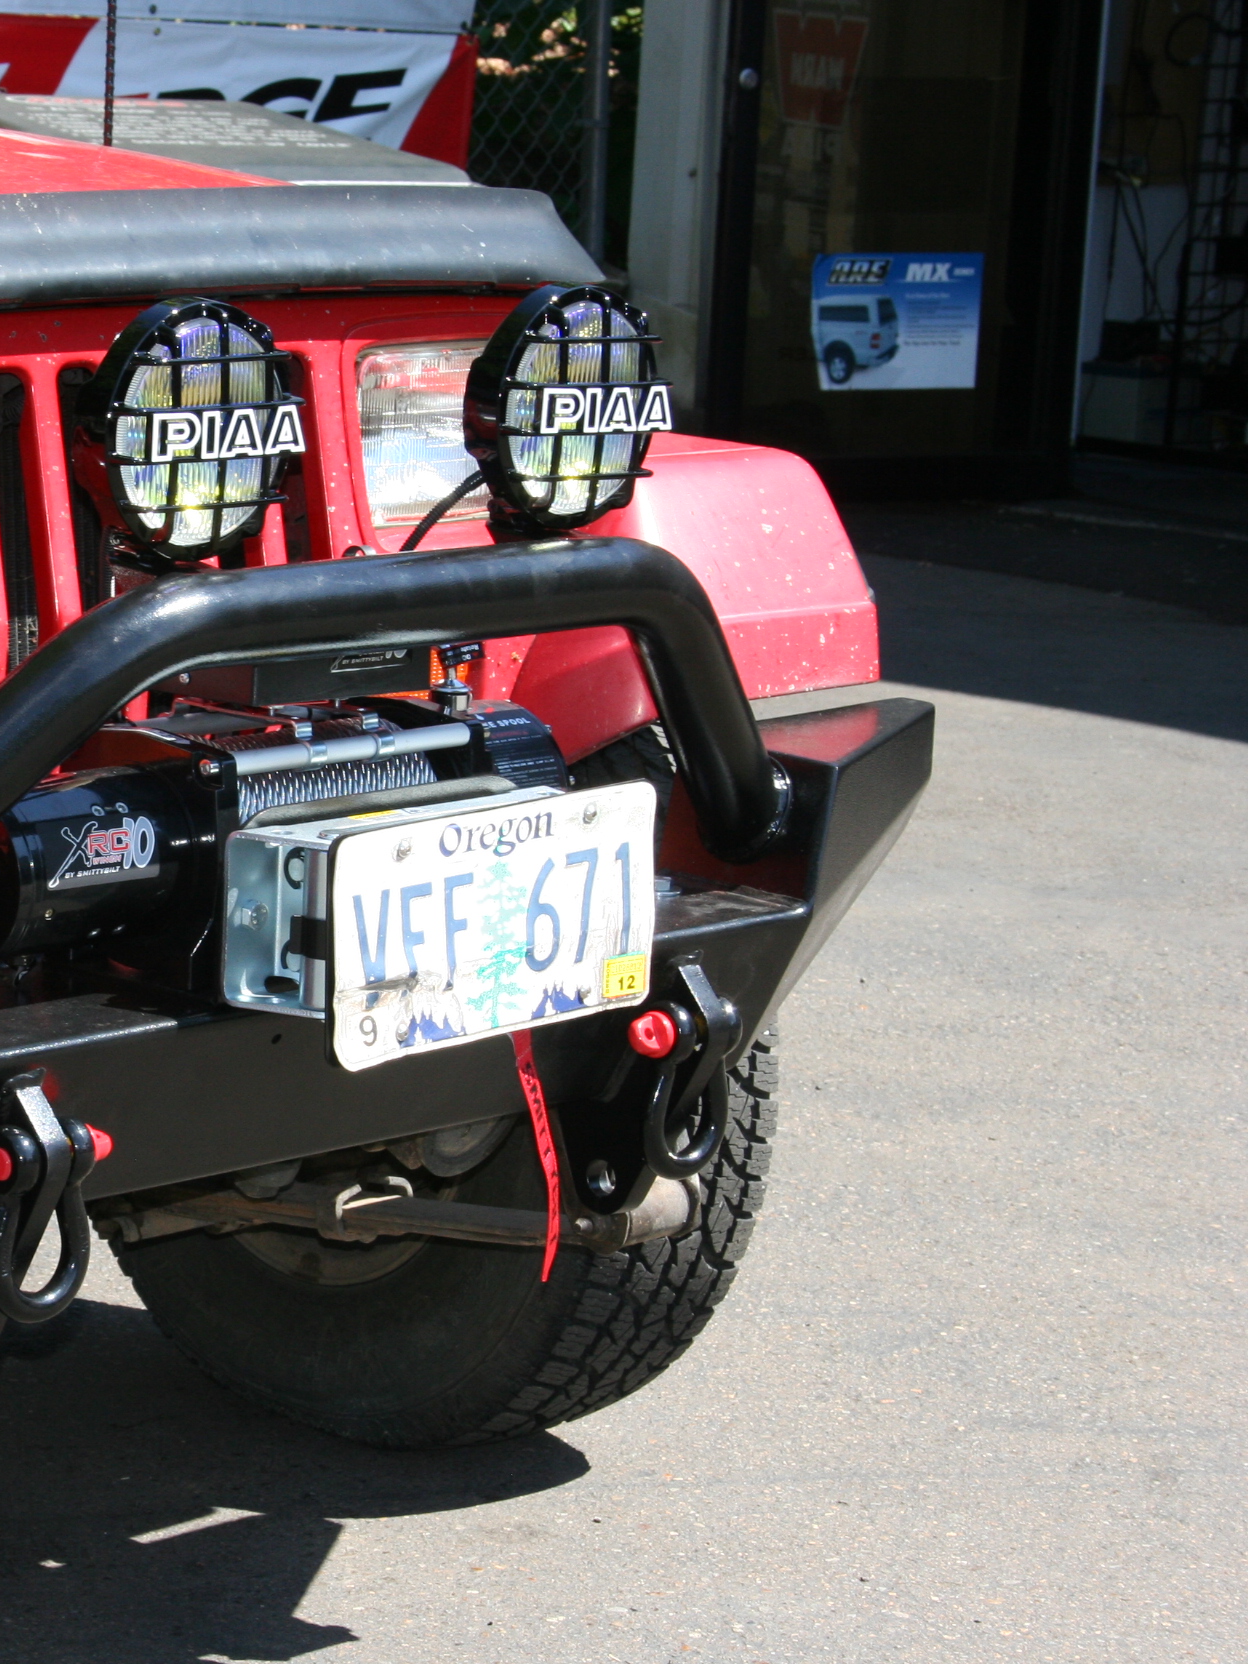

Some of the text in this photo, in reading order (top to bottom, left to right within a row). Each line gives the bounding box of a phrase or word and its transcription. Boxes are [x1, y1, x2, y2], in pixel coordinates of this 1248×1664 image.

[905, 262, 951, 281] MX
[540, 386, 673, 435] PIAA
[150, 405, 306, 463] PIAA
[498, 717, 531, 727] SPOOL
[438, 811, 554, 857] Oregon
[64, 865, 121, 879] BY SMITTYBILT
[525, 841, 631, 973] 671
[618, 975, 636, 991] 12
[358, 1014, 379, 1047] 9
